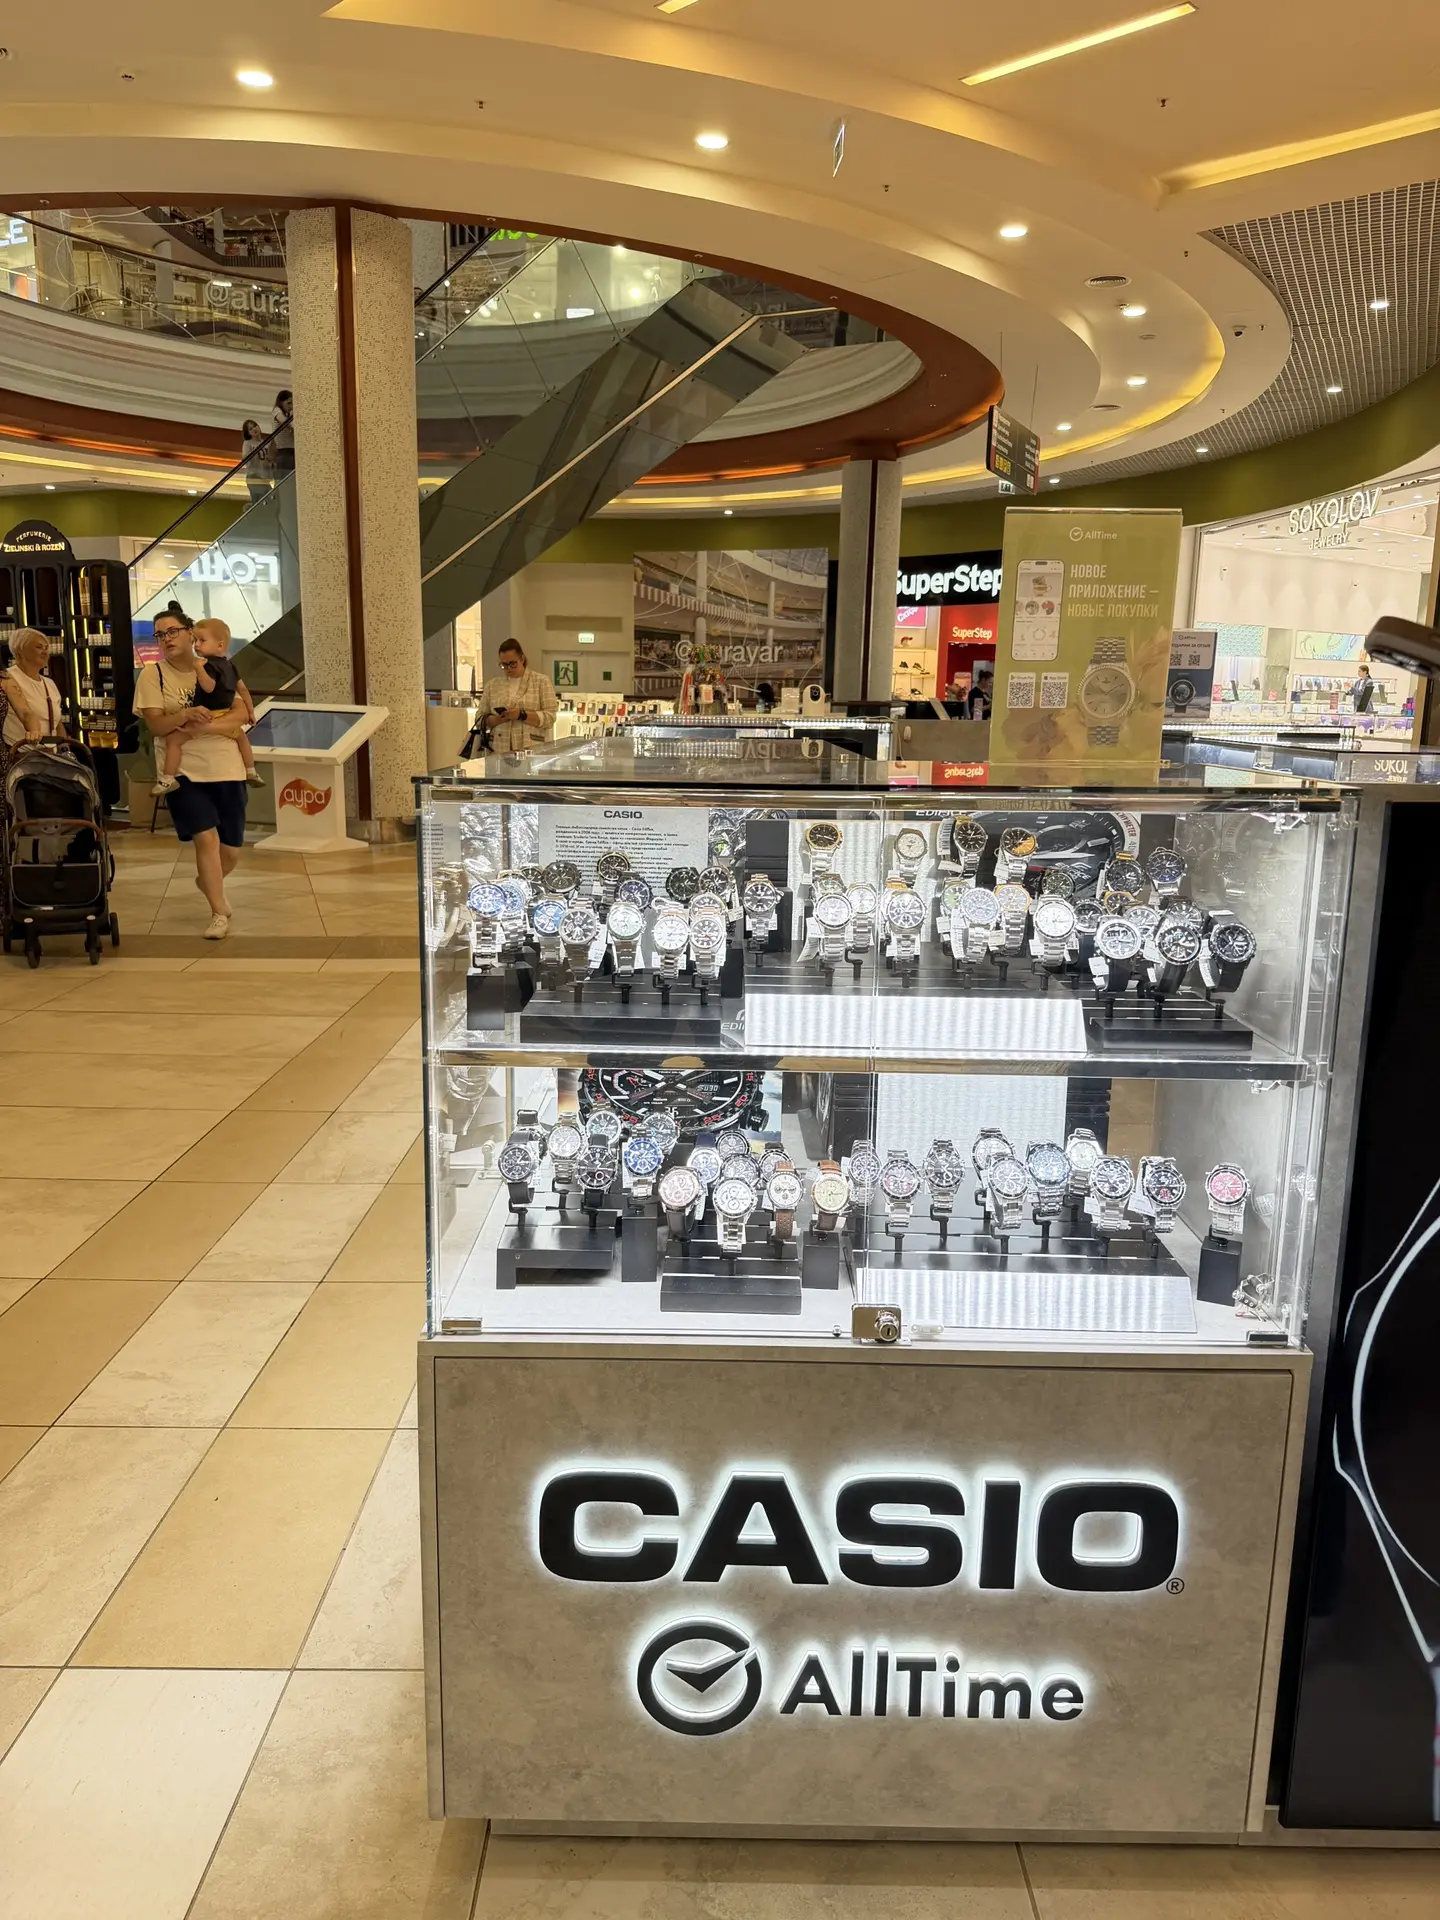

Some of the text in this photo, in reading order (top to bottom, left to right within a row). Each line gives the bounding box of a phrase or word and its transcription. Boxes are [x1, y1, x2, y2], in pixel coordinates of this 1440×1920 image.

[1289, 487, 1380, 536] SOKOLOV
[1084, 531, 1118, 540] AllTime
[1309, 531, 1352, 550] JEWELRY
[3, 543, 35, 553] ZIELINSKI
[41, 542, 65, 552] ROZEN
[1070, 564, 1107, 578] НОВОЕ
[1068, 584, 1147, 599] ПРИЛОЖЕНИЕ
[1067, 603, 1159, 618] НОВЫЕ ПОКУПКИ
[952, 626, 993, 641] SuperStep
[603, 810, 643, 819] CASIO
[539, 1471, 1179, 1592] CASIO
[779, 1645, 1085, 1721] AllTime
